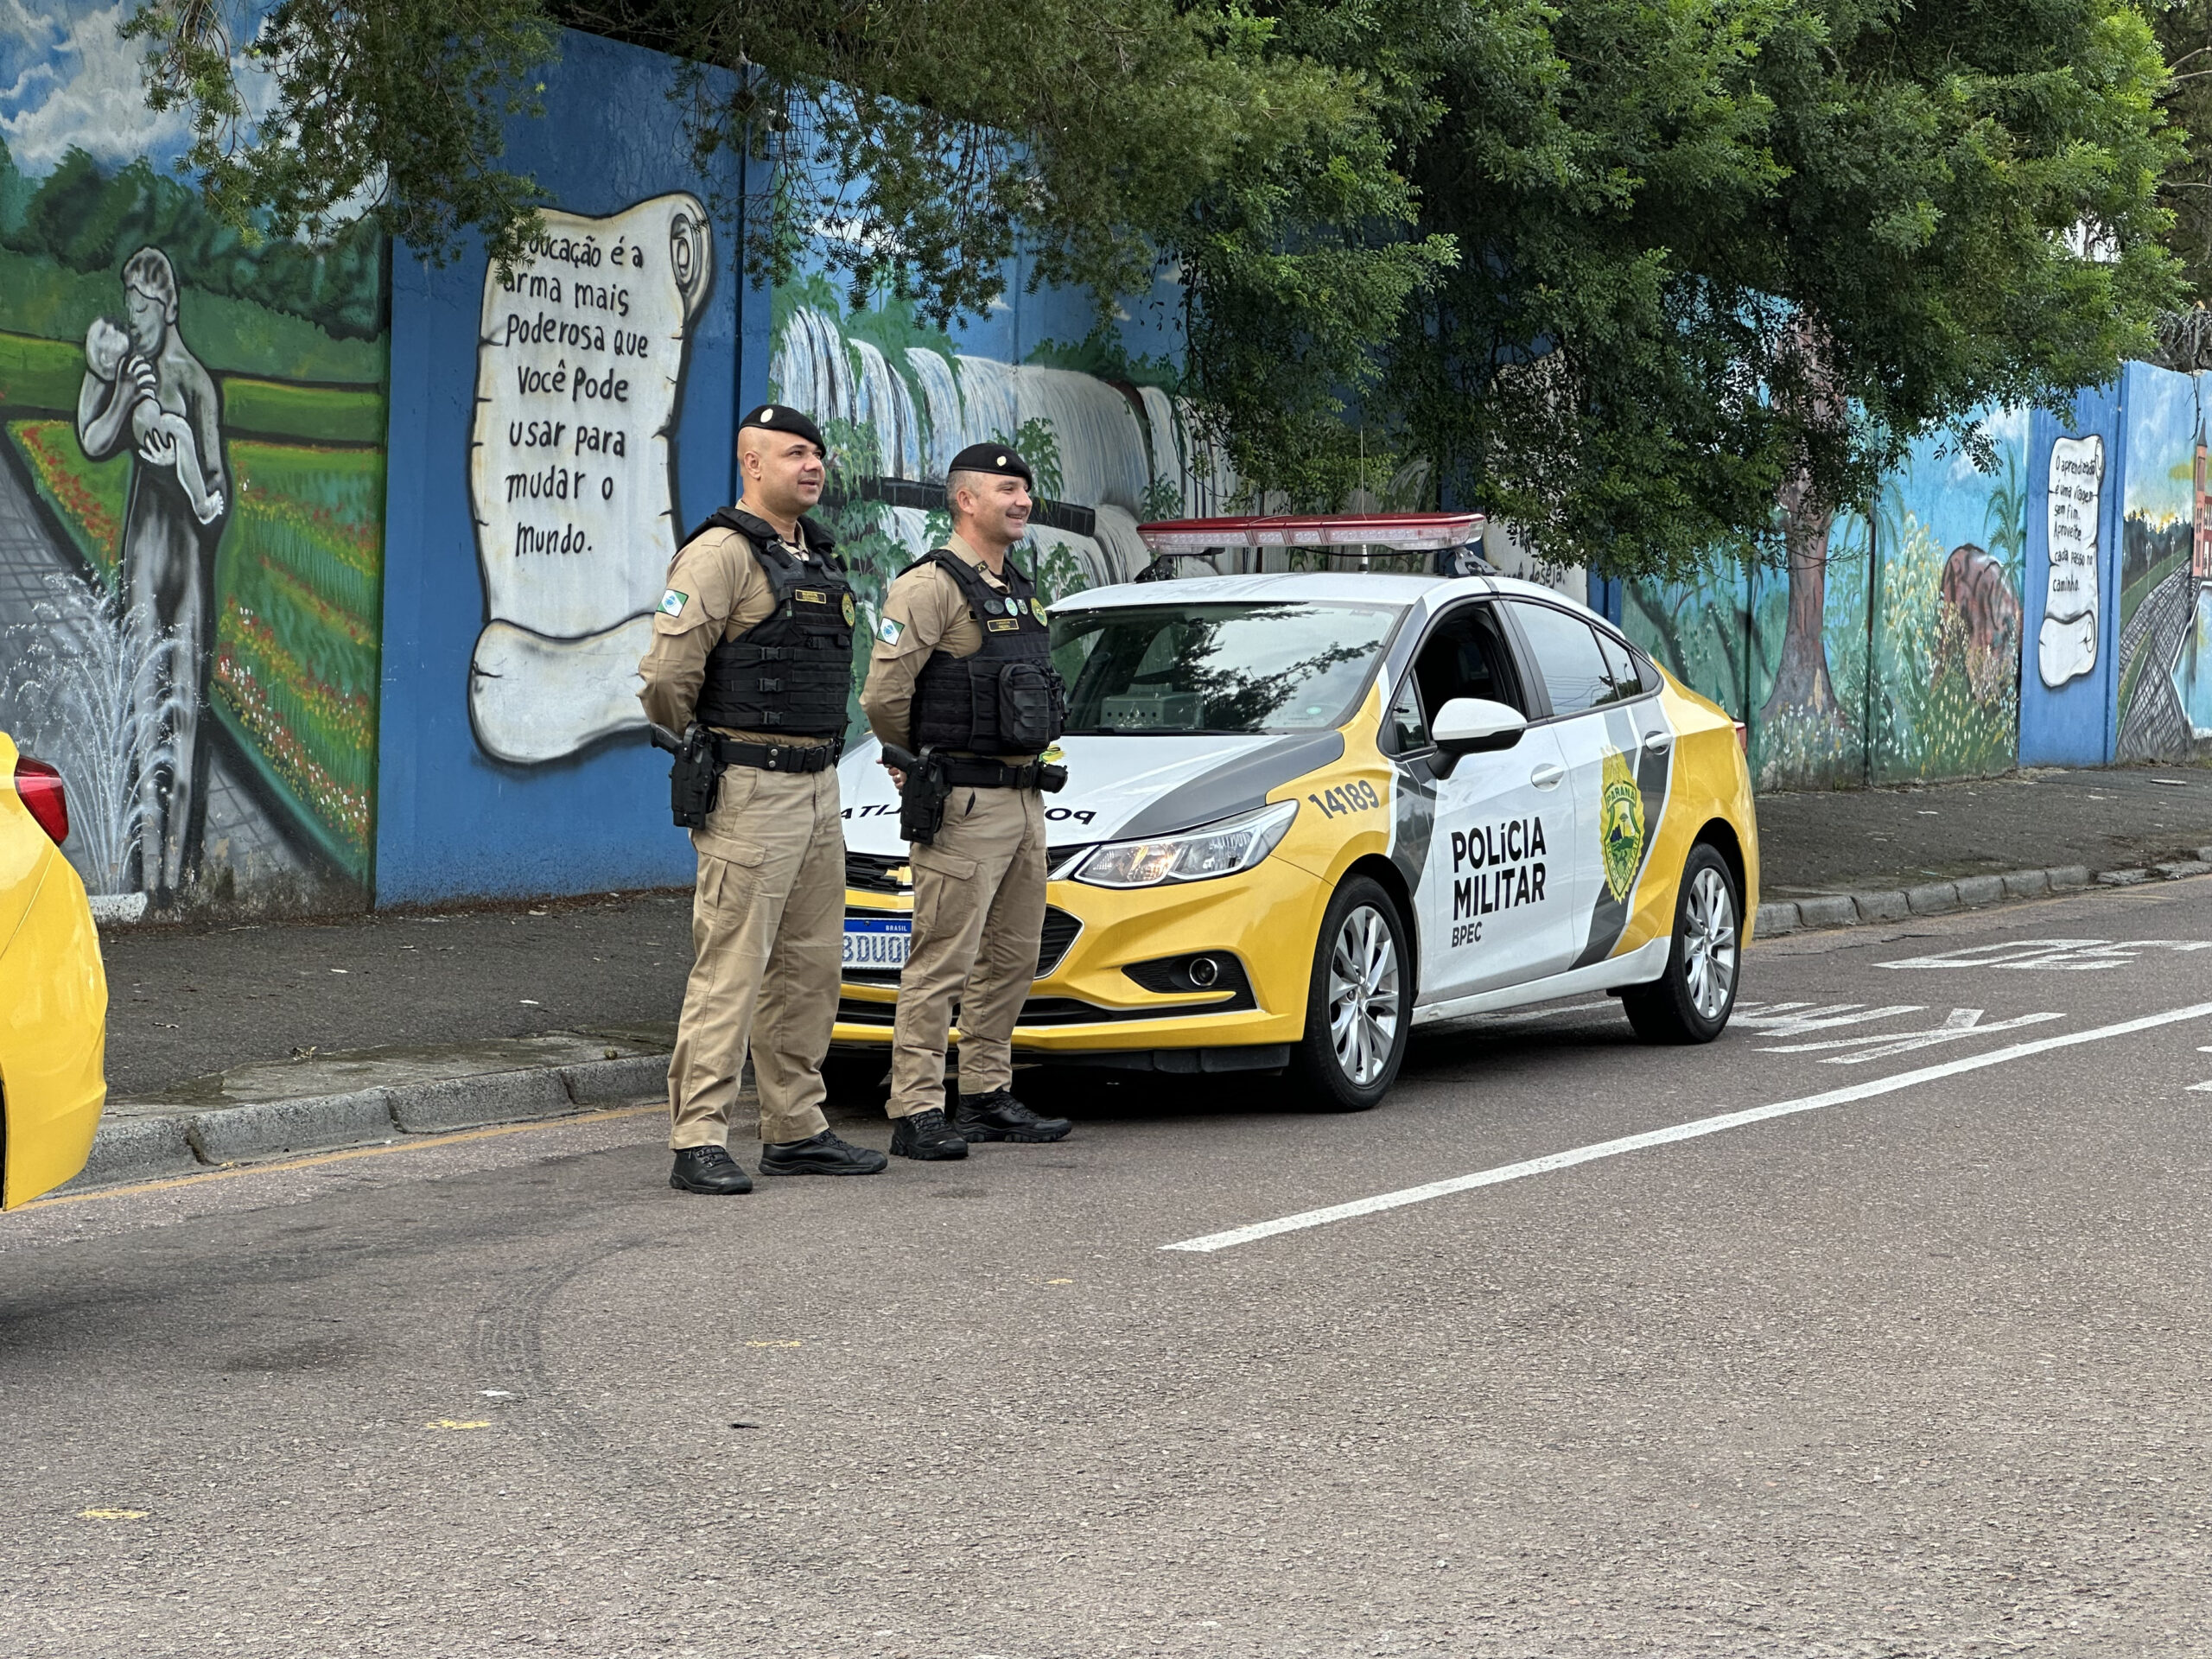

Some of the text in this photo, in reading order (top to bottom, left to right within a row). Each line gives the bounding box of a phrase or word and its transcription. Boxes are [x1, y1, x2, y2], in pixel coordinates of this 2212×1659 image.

[610, 235, 625, 265] é
[631, 245, 644, 269] a
[575, 283, 629, 317] mais
[509, 419, 625, 458] usar para
[505, 464, 613, 504] mudar o
[1307, 779, 1380, 820] 14189
[1606, 785, 1636, 806] PARANÁ
[1451, 817, 1547, 874] POLÍCIA
[1452, 862, 1546, 921] MILITAR
[1452, 921, 1483, 949] BPEC
